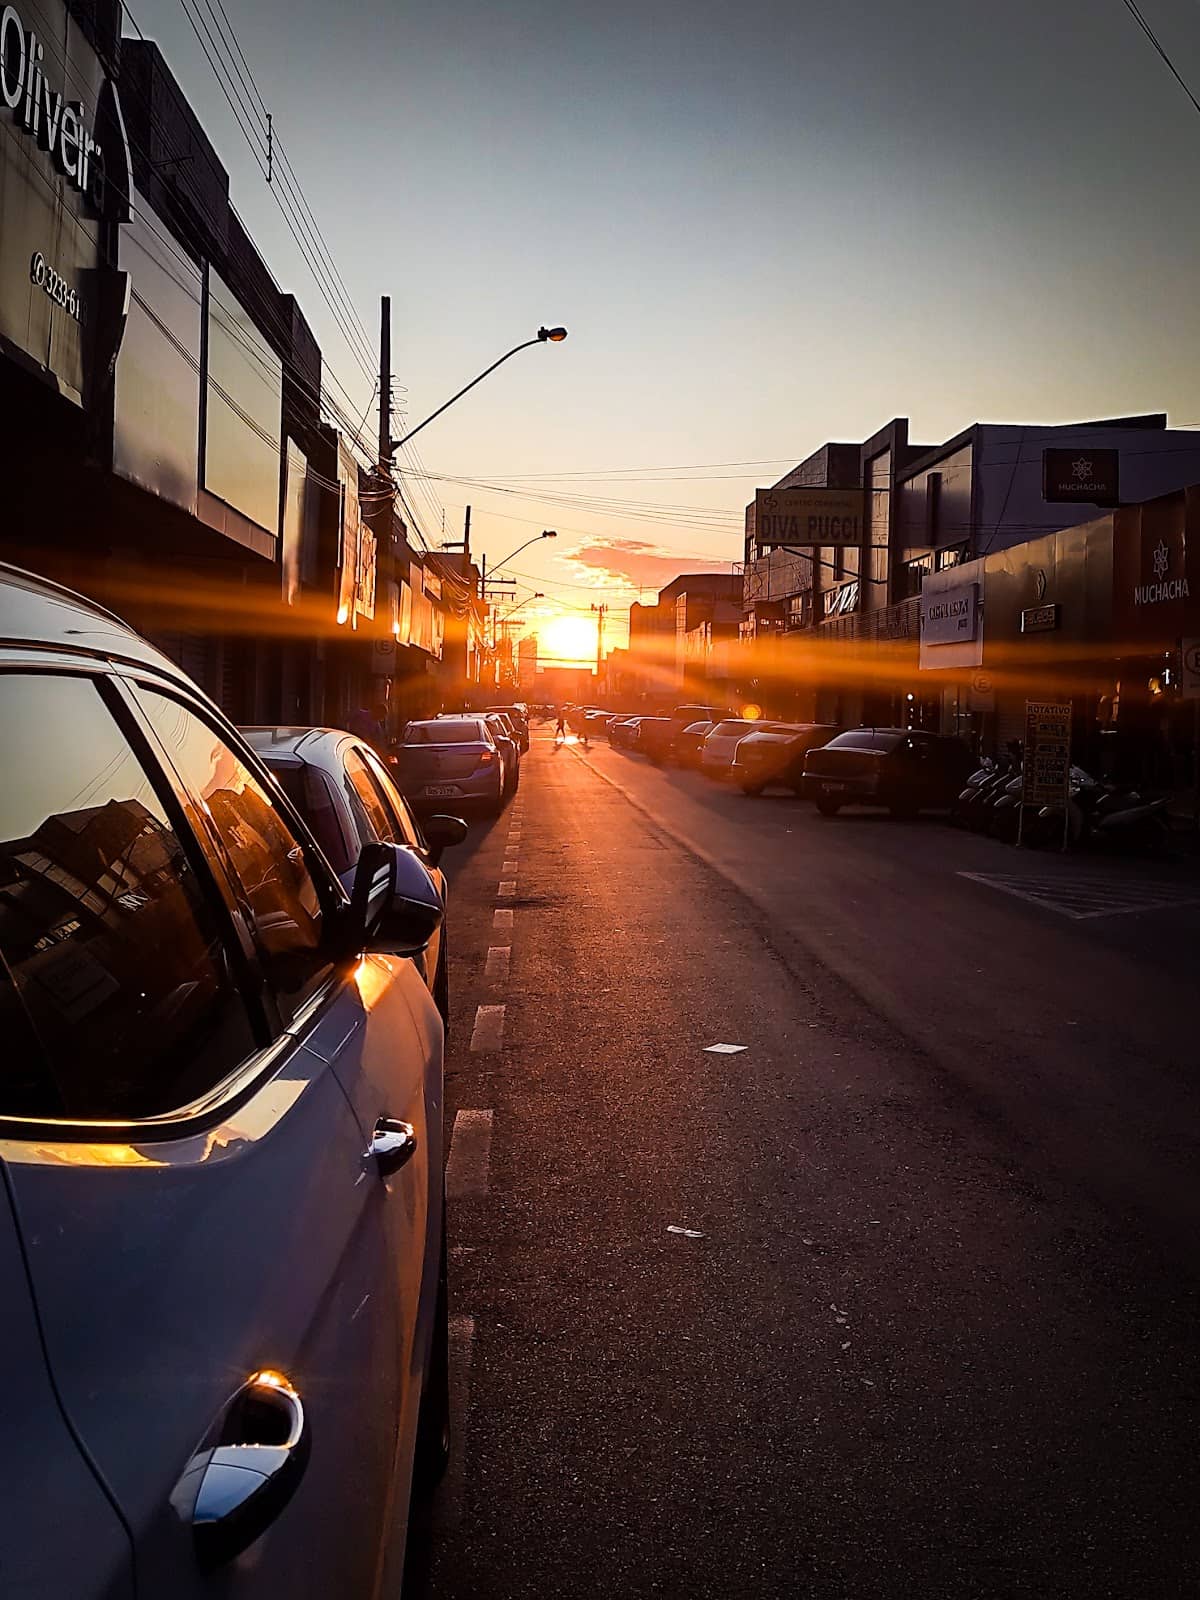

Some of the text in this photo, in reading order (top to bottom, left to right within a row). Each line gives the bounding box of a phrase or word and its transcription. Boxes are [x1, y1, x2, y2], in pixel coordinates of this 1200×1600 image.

[1058, 483, 1107, 492] MUCHACHA
[761, 514, 858, 542] DIVA PUCCI
[1134, 578, 1190, 606] MUCHACHA
[1027, 705, 1070, 714] ROTATIVO
